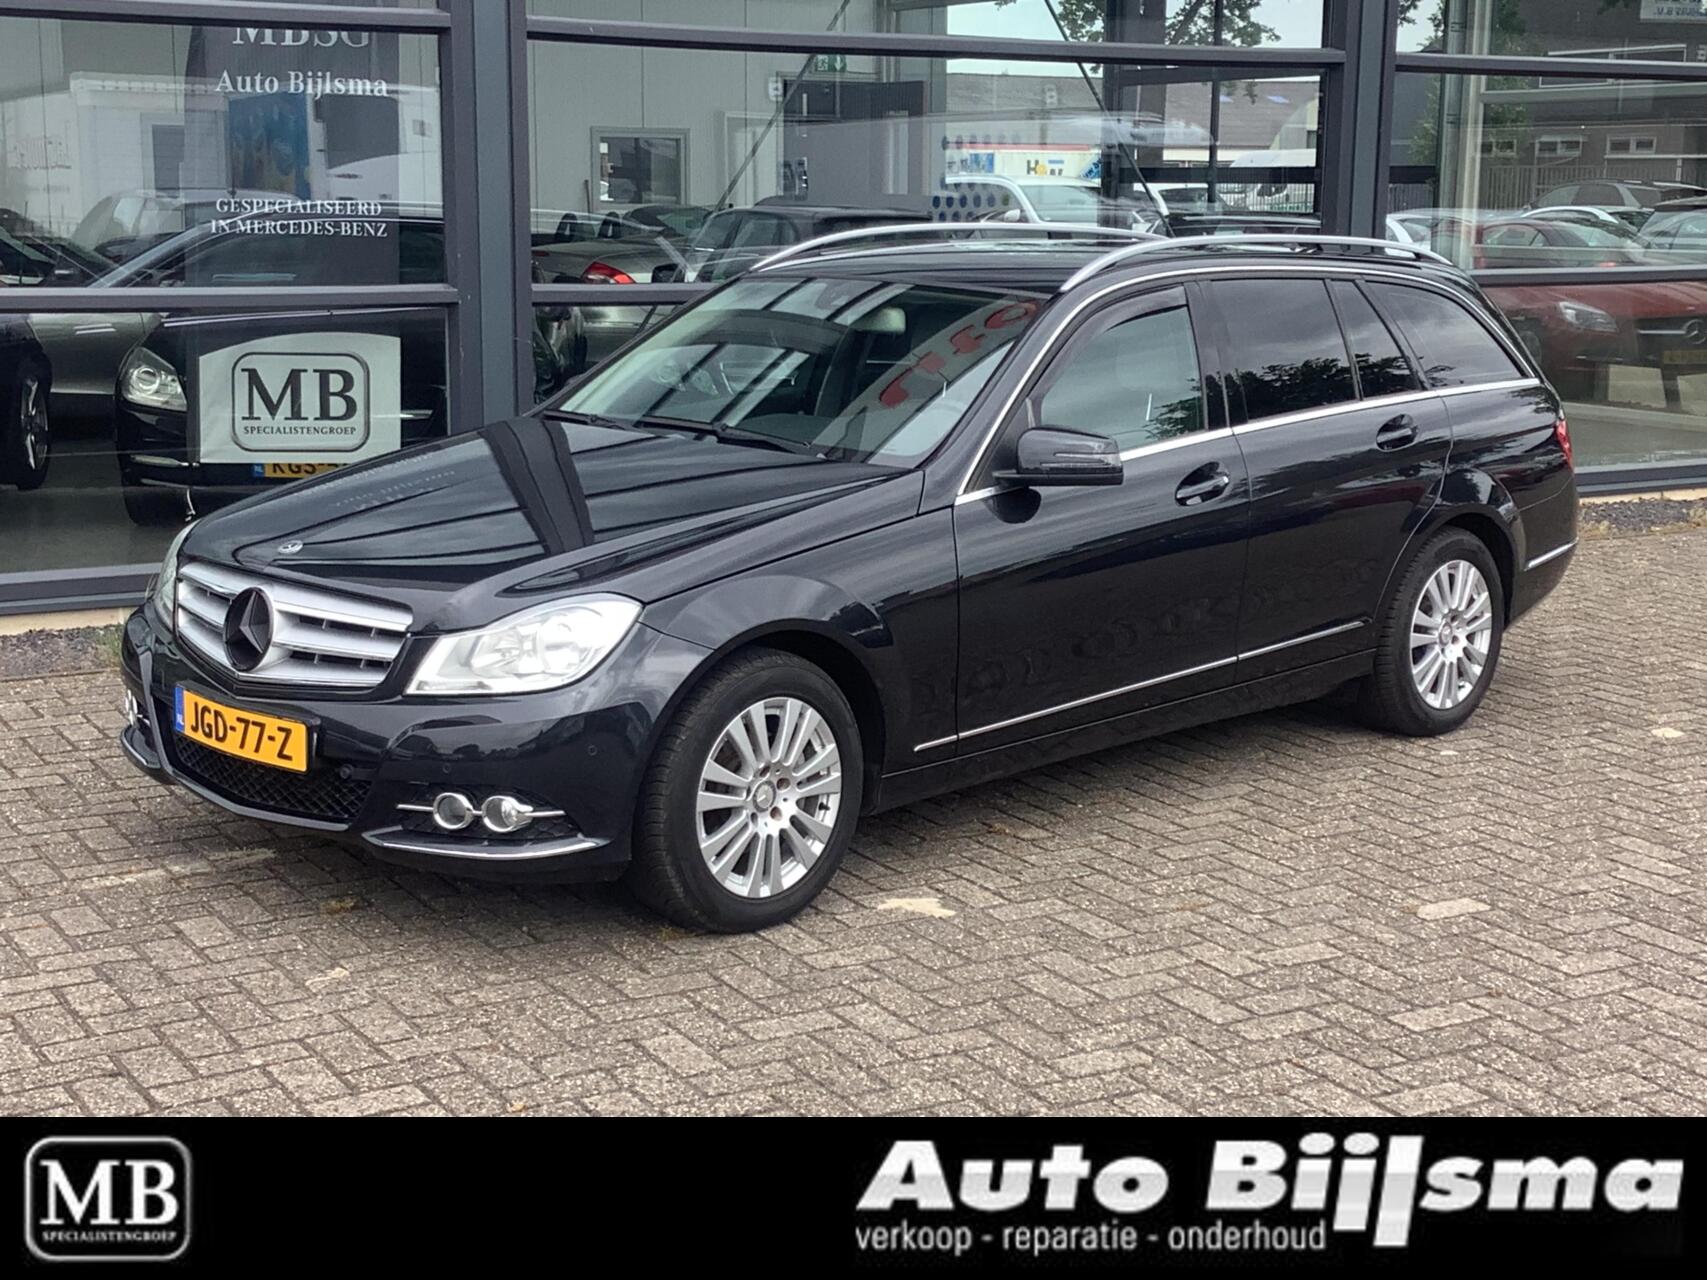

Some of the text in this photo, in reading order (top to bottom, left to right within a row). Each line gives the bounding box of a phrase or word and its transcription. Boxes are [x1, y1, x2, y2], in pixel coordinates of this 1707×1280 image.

[215, 70, 389, 100] Auto Bijlsma
[215, 198, 382, 217] GESPECIALISEERD
[211, 219, 388, 238] IN MERCEDES-BENZ
[241, 368, 357, 421] MB
[243, 425, 357, 436] SPECIALISTENGROEP
[190, 701, 293, 761] JGD-77-Z
